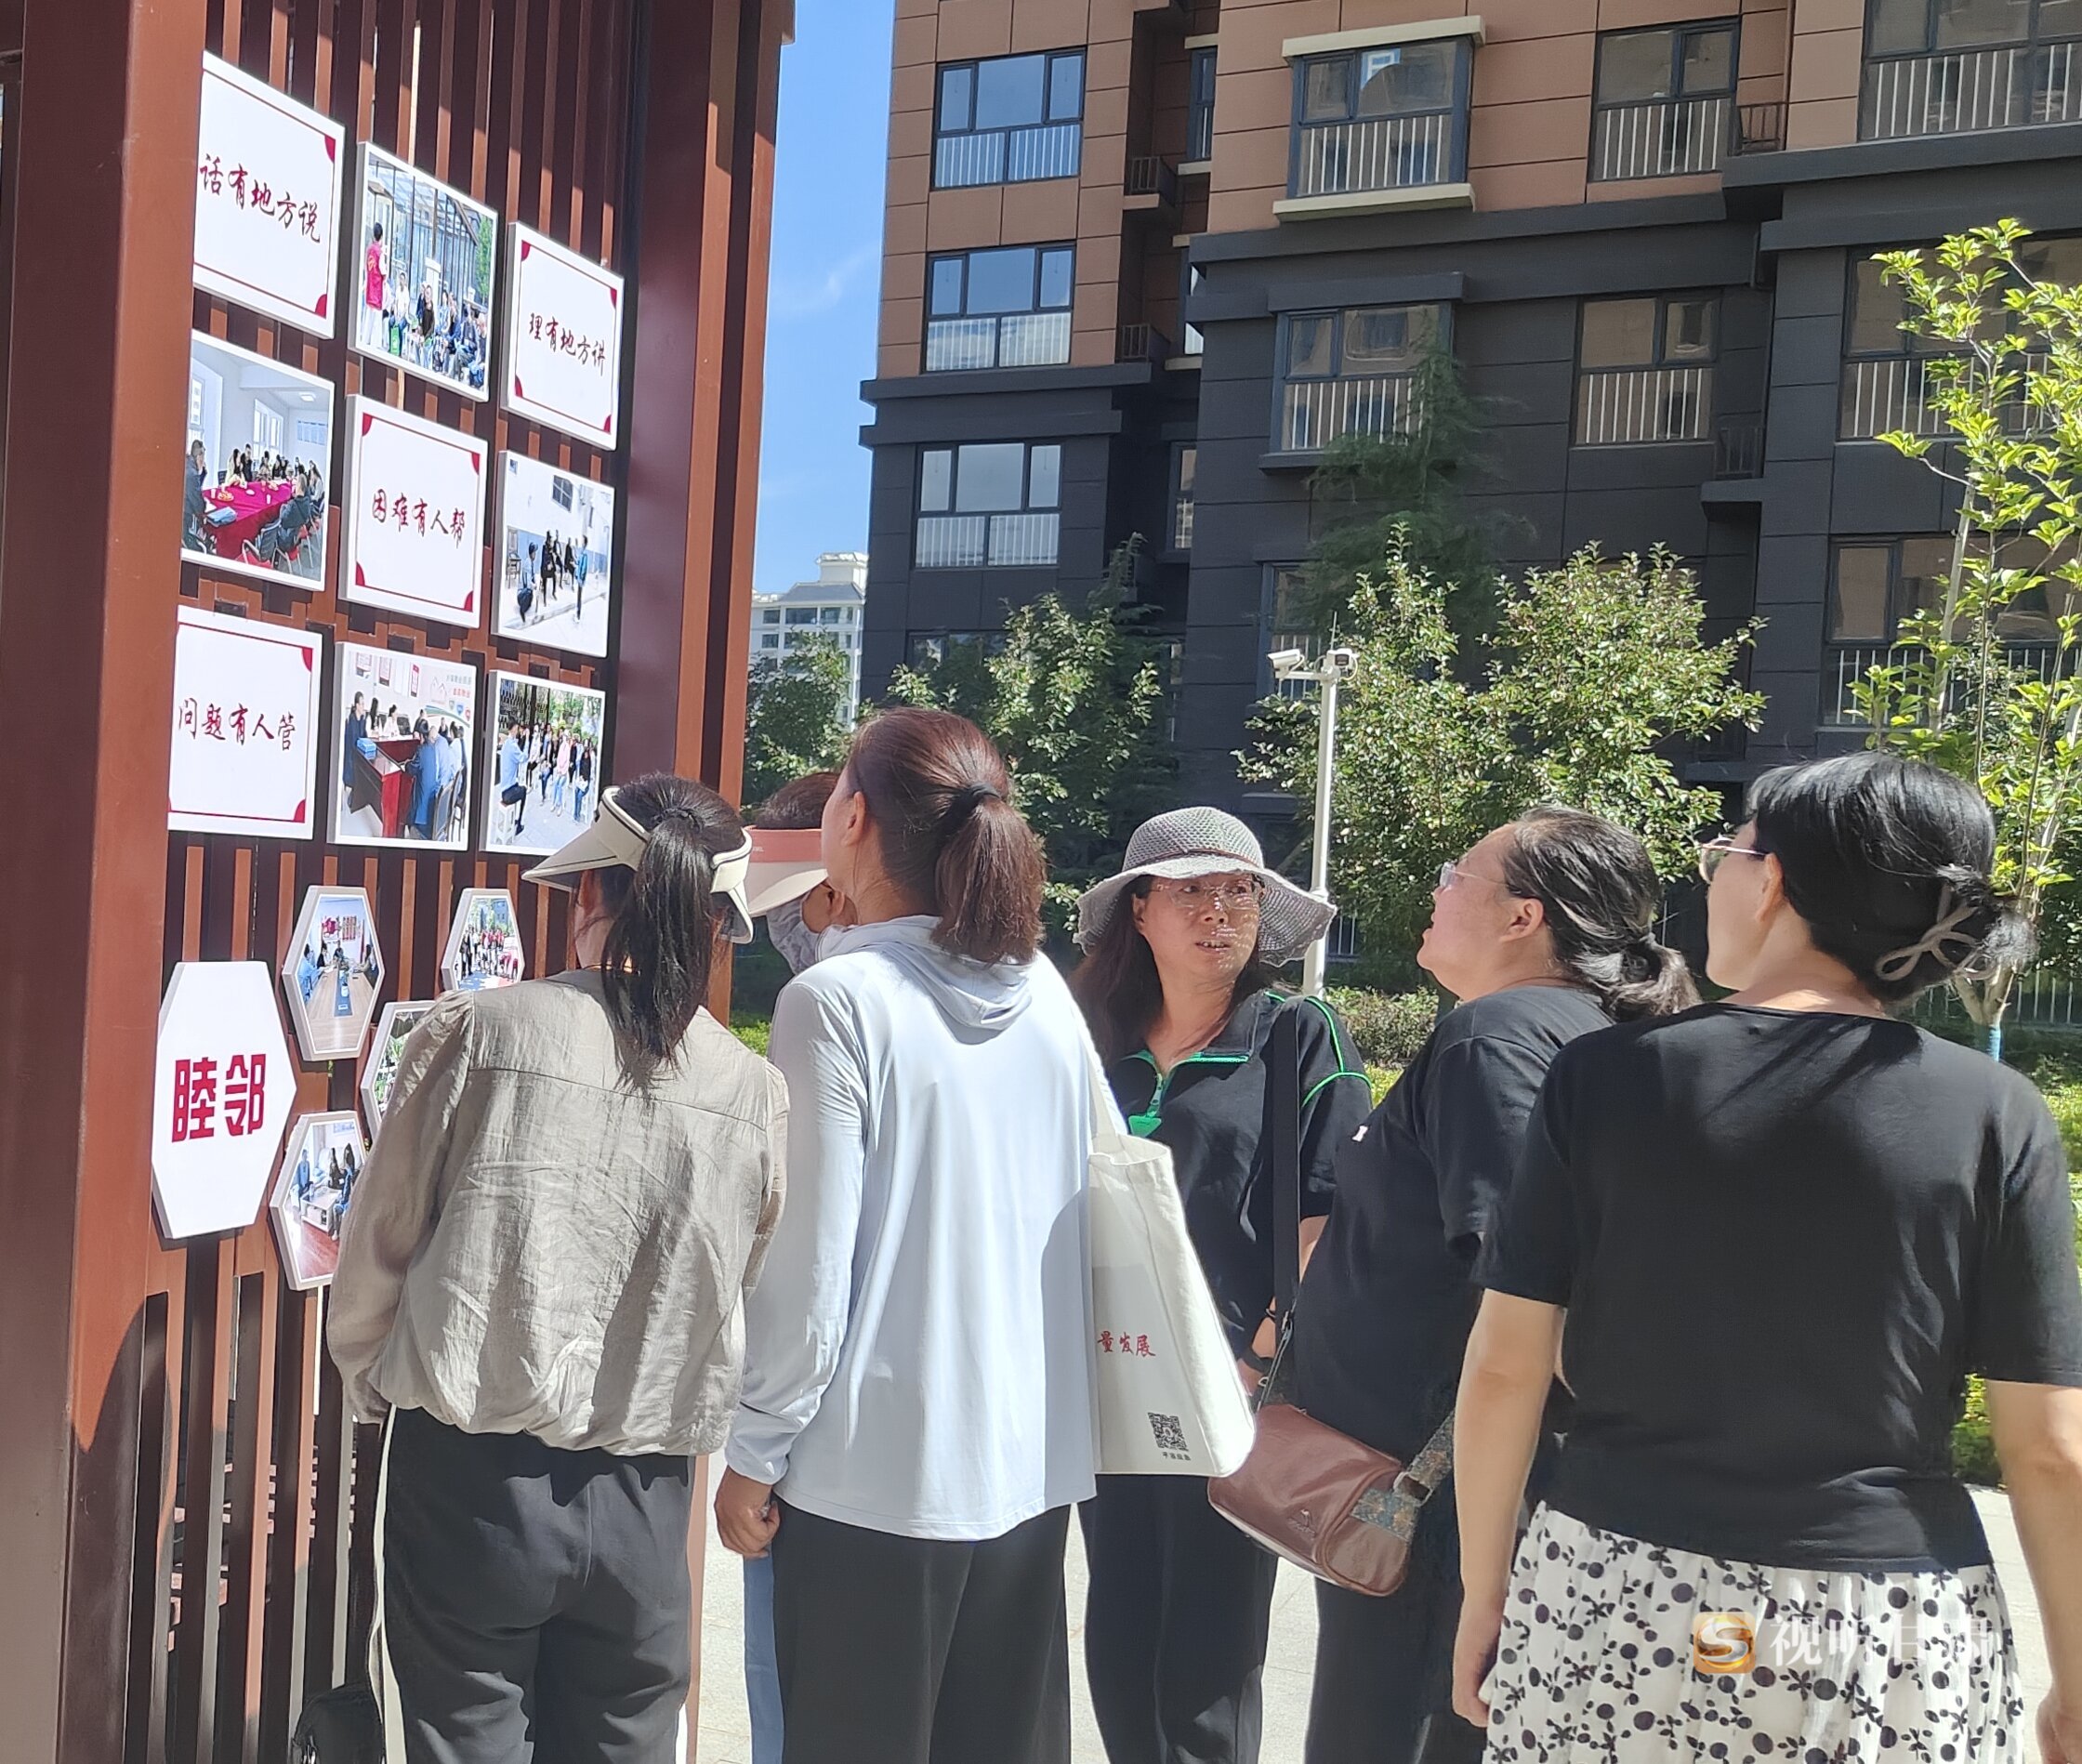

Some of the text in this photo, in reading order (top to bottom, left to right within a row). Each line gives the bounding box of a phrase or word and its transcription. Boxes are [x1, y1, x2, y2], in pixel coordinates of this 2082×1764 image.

[200, 153, 321, 244] 话有地方说
[529, 312, 606, 376] 理有地方讲
[372, 489, 465, 549] 困难有人帮
[178, 697, 296, 751] 问题有人管
[172, 1054, 266, 1143] 睦邻
[1097, 1330, 1156, 1357] 量发展
